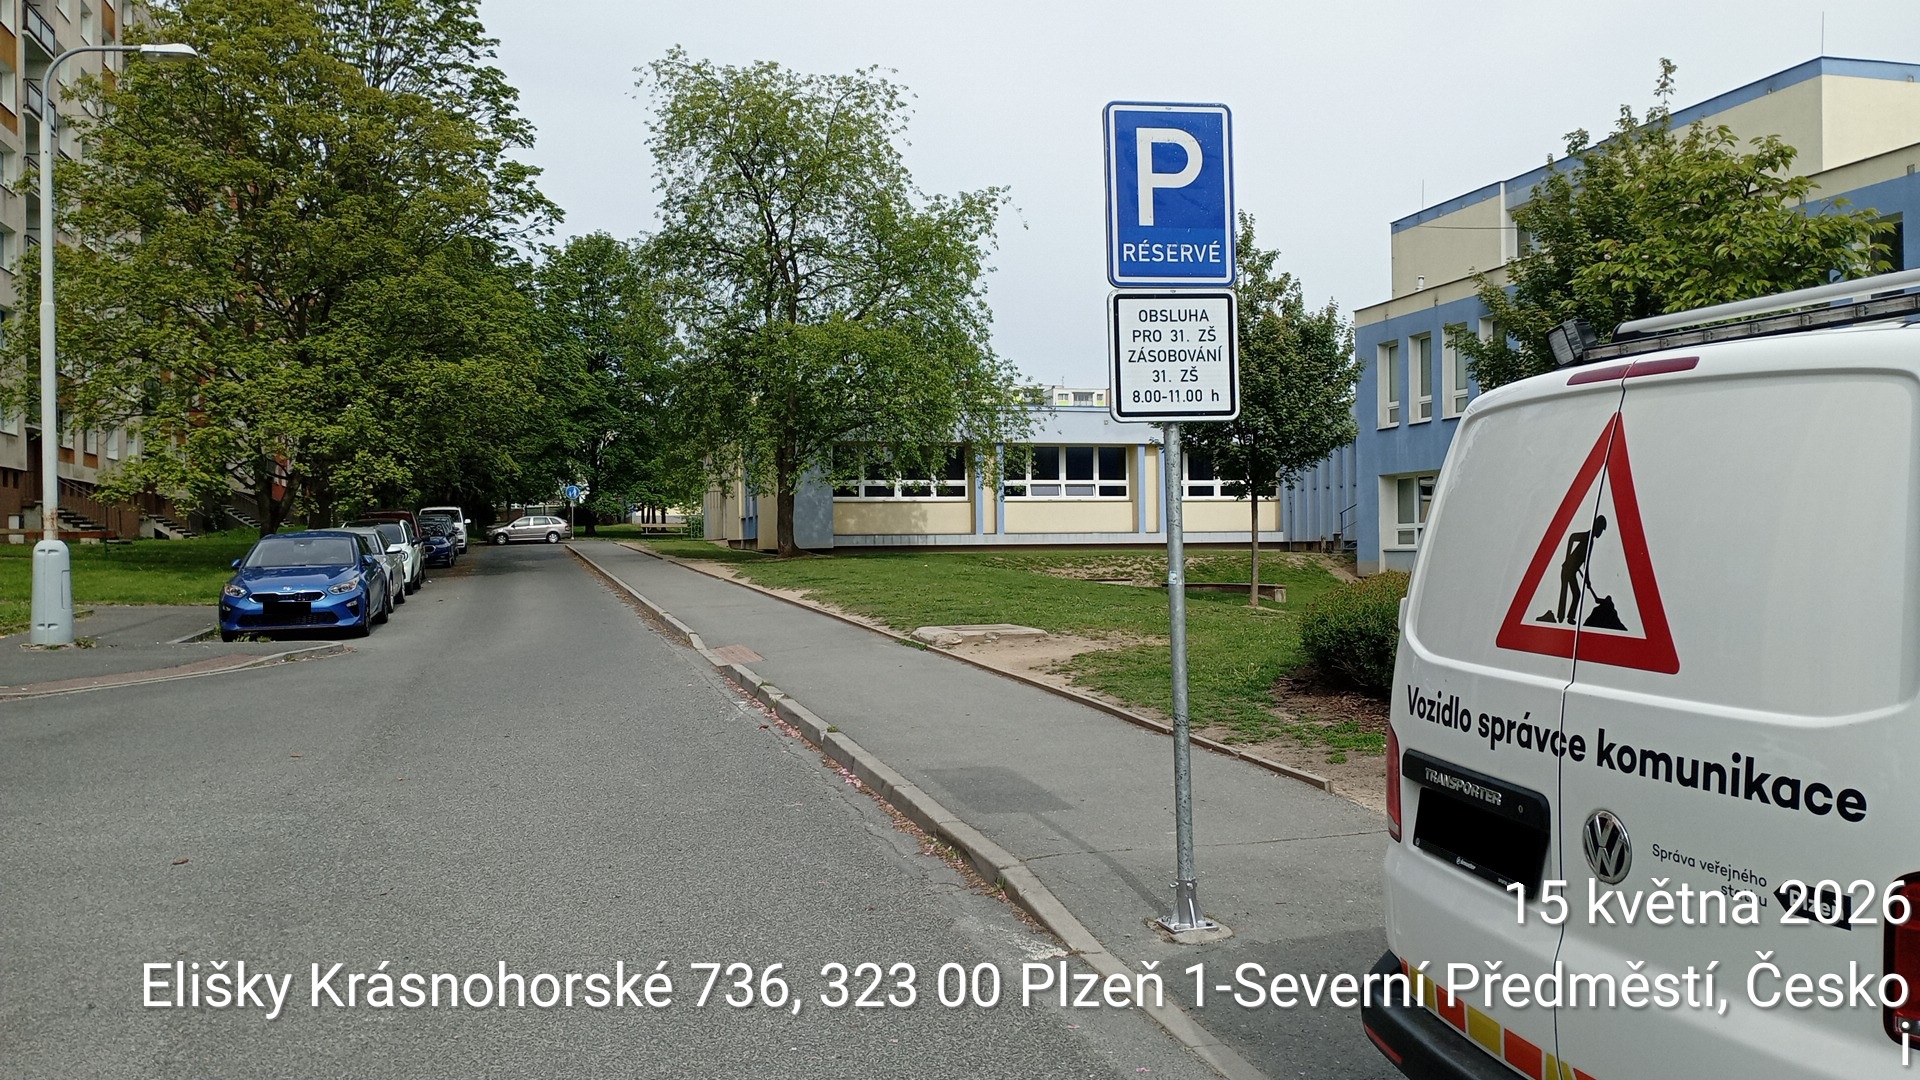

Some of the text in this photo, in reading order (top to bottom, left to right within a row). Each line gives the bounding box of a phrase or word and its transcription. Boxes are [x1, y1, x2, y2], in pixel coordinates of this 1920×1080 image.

[1136, 127, 1203, 226] P
[1123, 239, 1221, 263] RÉSERVÉ
[1138, 309, 1209, 322] OBSLUHA
[1132, 325, 1217, 343] PRO 31. ZŠ
[1128, 345, 1222, 363] ZÁSOBOVÁNÍ
[1152, 366, 1199, 383] 31. ZŠ
[1132, 389, 1220, 403] 8.00-11.00 h
[1407, 684, 1867, 823] Vozidlo správce komunikace
[1425, 766, 1502, 806] TRANSPORTER
[1652, 843, 1768, 888] Správa veřejného
